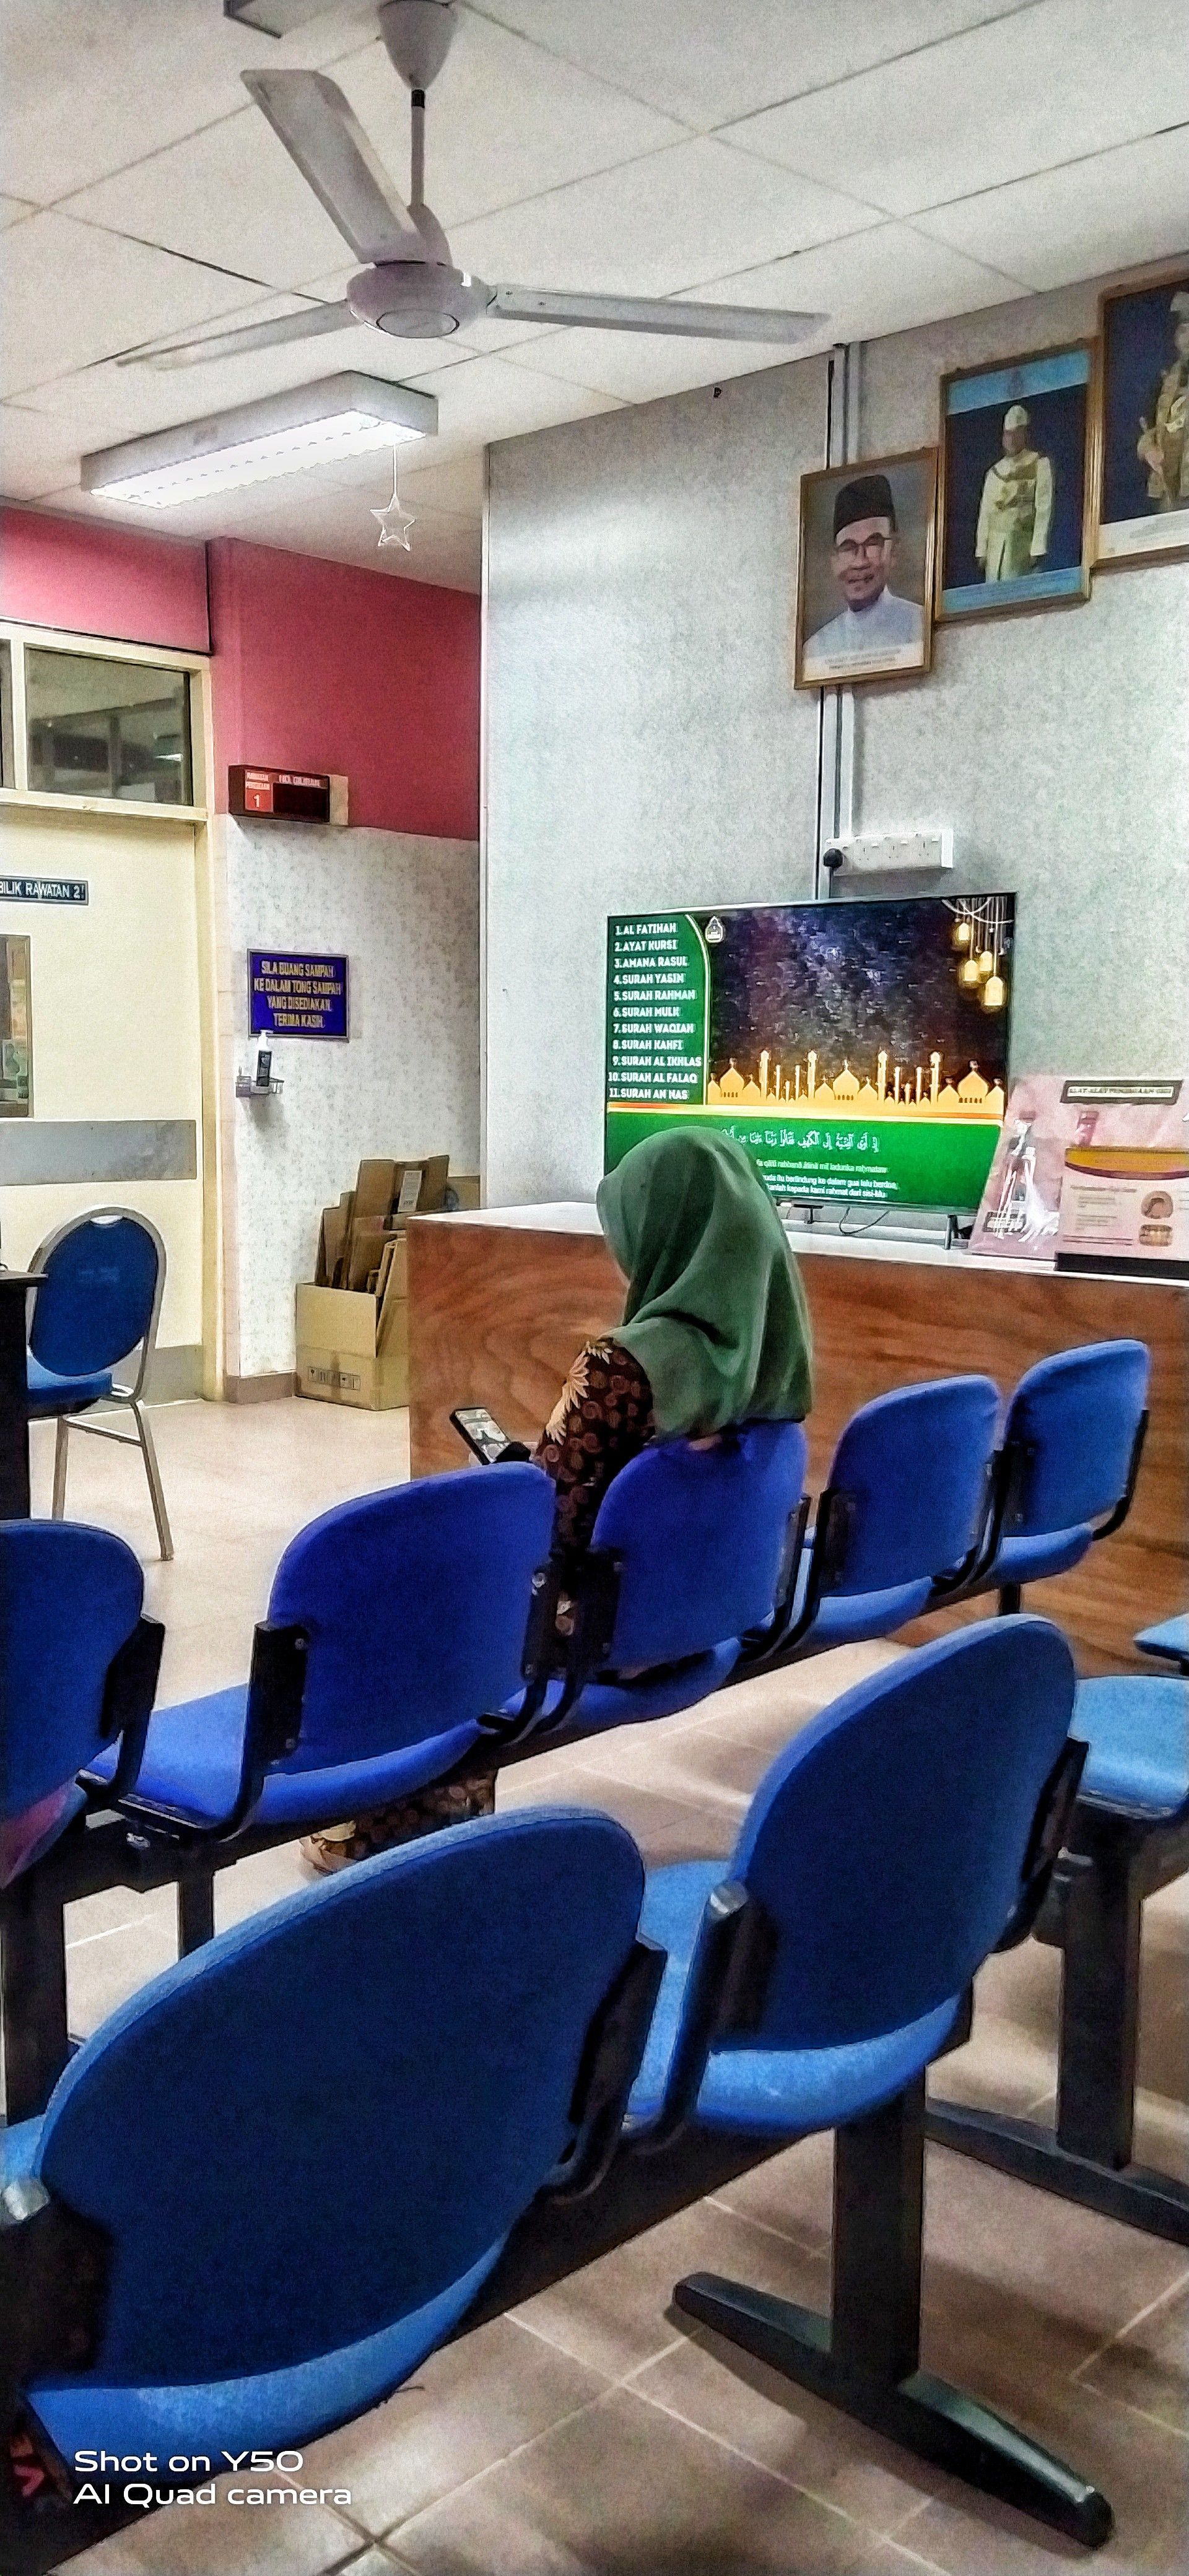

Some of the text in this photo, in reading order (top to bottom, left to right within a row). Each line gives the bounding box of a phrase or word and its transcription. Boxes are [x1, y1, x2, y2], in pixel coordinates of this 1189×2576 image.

[253, 794, 260, 807] 1
[0, 881, 22, 896] BILIK
[25, 882, 70, 898] RAWATAN
[636, 923, 676, 934] FATIHAH
[648, 939, 677, 951] KURSI
[658, 956, 688, 967] RASUL
[261, 960, 334, 978] SILA BUANG SAMPAH
[654, 973, 684, 983] YASIN
[254, 978, 341, 995] KE DALAM TONG SAMPAH
[655, 990, 695, 1000] RAHMAN
[267, 995, 287, 1009] YANG
[655, 1007, 679, 1017] MULK
[273, 1013, 300, 1027] TERIMA
[654, 1023, 694, 1033] WAQIAH
[654, 1039, 683, 1050] KAHFI
[653, 1056, 666, 1066] AL
[667, 1056, 702, 1066] IKHLAS
[653, 1073, 665, 1082] AL
[666, 1073, 698, 1083] FALAQ
[653, 1089, 666, 1099] AN
[669, 1089, 688, 1099] NAS
